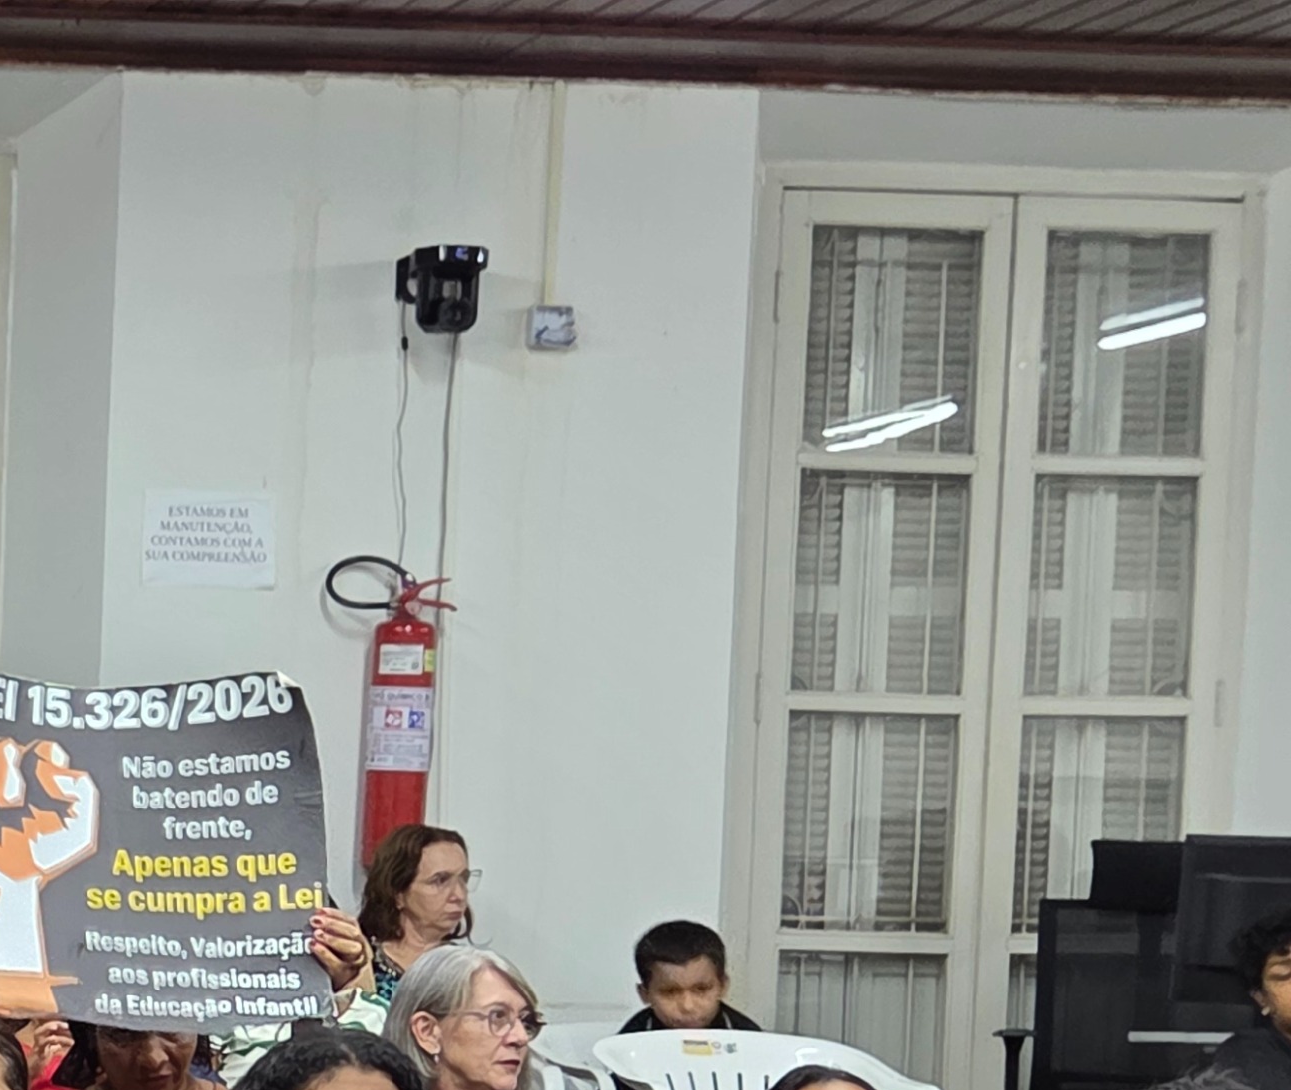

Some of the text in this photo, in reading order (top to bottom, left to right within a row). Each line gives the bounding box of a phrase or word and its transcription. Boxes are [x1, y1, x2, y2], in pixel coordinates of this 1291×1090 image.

[168, 505, 249, 518] ESTAMOS EM
[145, 549, 169, 561] SUA
[150, 535, 264, 548] CONTAMOS COM A
[27, 674, 293, 731] 15.326/2026
[122, 748, 291, 779] Não estamos
[132, 780, 279, 810] batendo de
[163, 816, 253, 841] frente,
[111, 849, 297, 882] Apenas que
[86, 882, 323, 919] se cumpra a Lei
[85, 931, 188, 959] Respeito,
[108, 967, 301, 990] aos profissionais
[95, 994, 318, 1023] da Educação Infantil
